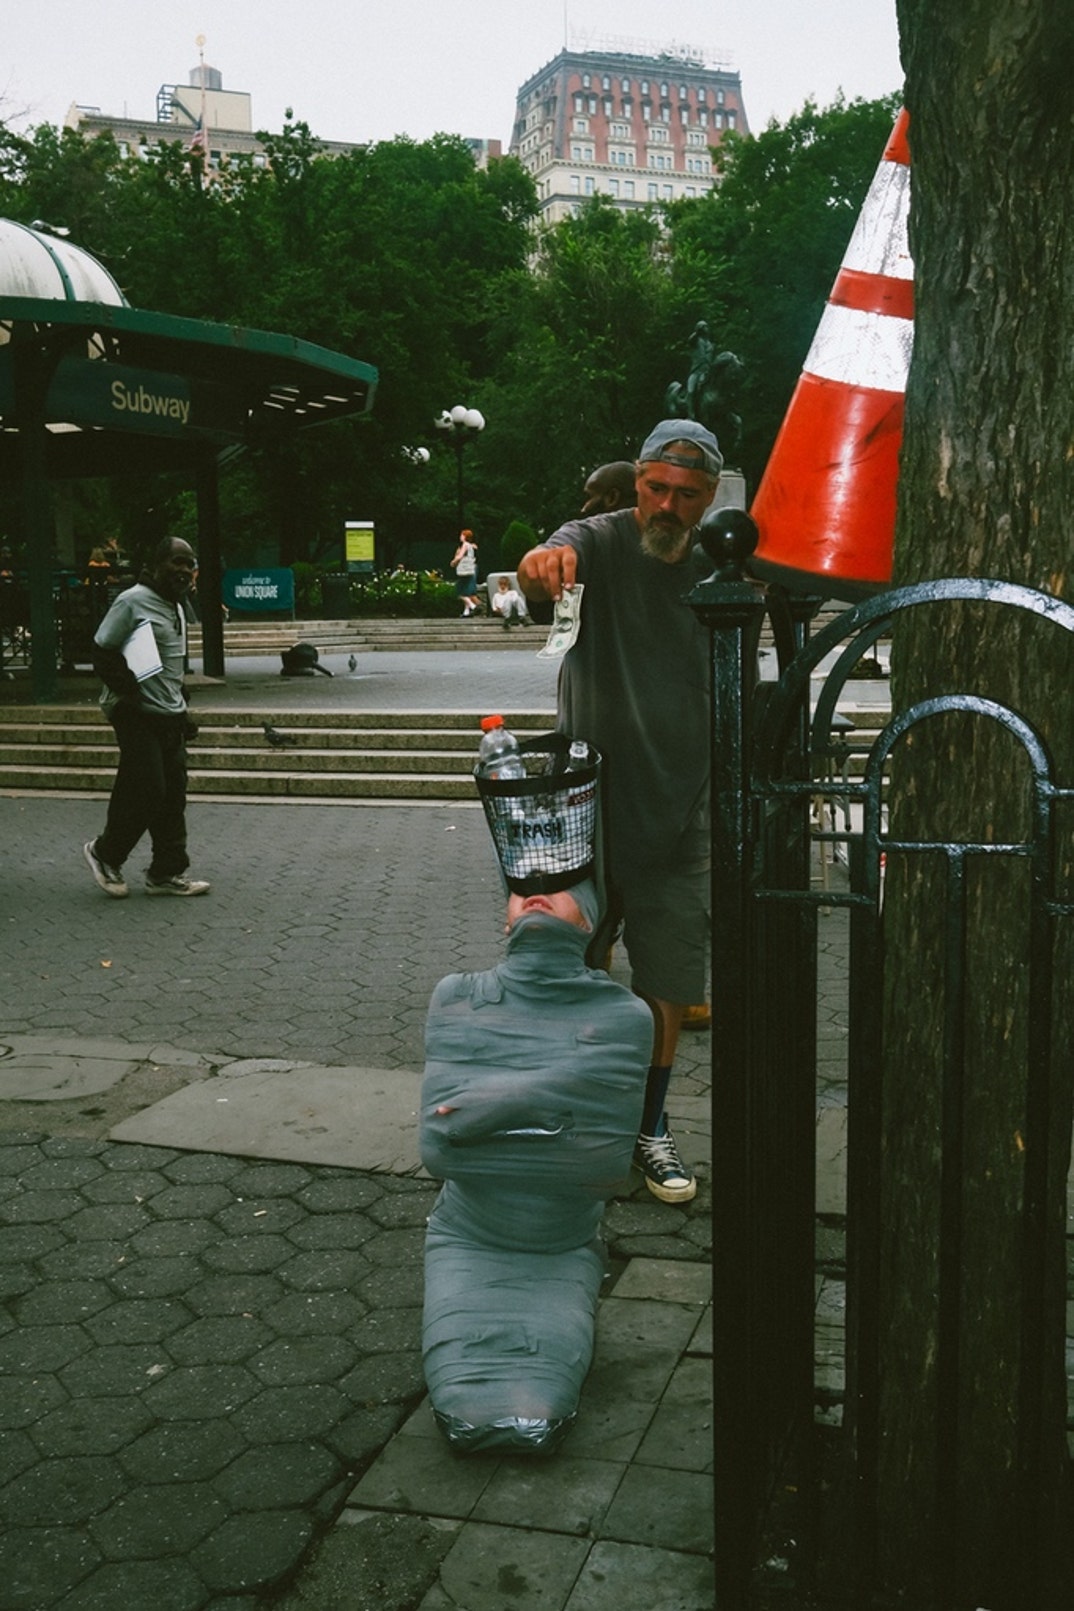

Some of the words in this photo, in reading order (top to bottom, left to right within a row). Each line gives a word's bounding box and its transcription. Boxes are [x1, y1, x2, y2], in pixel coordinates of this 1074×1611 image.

[111, 380, 190, 424] Subway
[234, 585, 254, 598] UNION
[254, 585, 278, 600] SQUARE
[510, 820, 563, 839] TRASH
